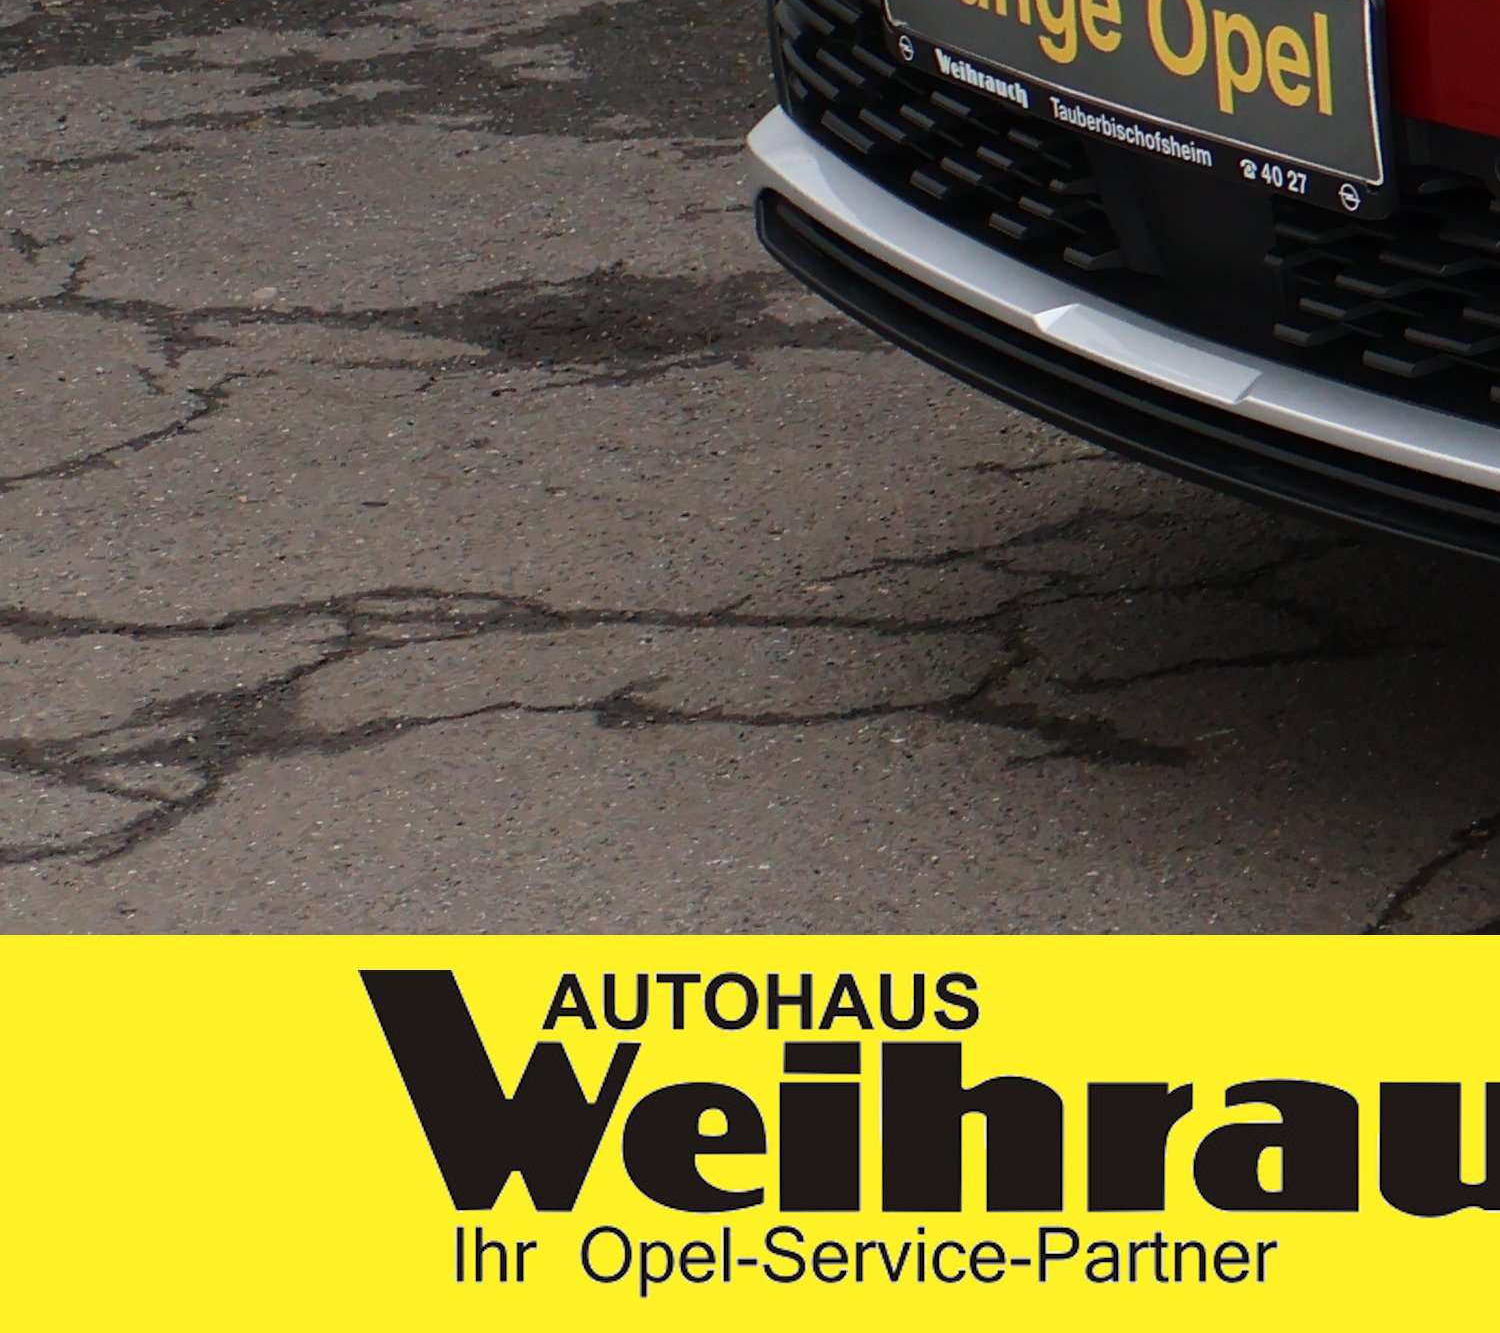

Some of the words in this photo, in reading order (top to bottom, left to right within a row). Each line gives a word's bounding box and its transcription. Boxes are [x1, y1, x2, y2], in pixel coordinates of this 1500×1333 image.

[934, 47, 1029, 110] Weihrauch
[1049, 95, 1213, 168] Tauberbischofsheim
[1260, 161, 1284, 190] 40
[1286, 172, 1308, 195] 27
